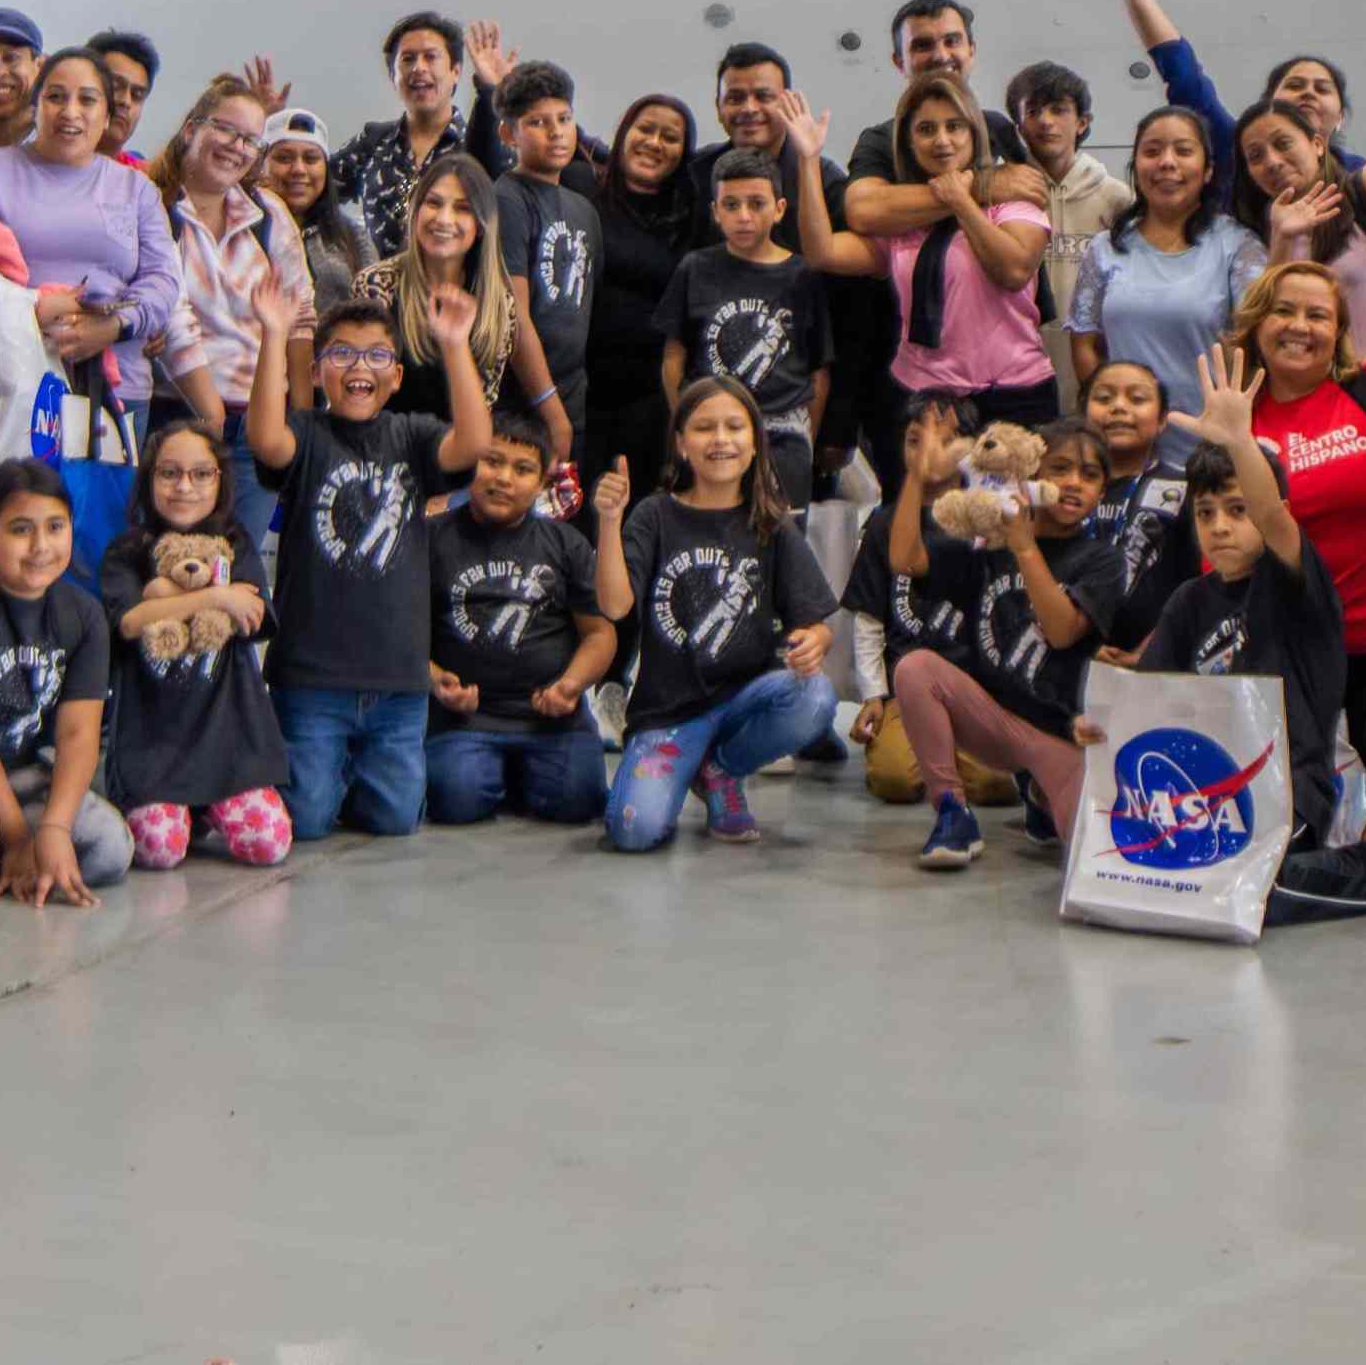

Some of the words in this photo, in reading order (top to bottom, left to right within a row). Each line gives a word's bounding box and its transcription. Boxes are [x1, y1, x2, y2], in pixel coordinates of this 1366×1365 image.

[706, 323, 722, 340] IS
[714, 301, 739, 325] FAR
[739, 298, 764, 313] OUT
[1288, 432, 1307, 448] EL
[1288, 423, 1359, 458] CENTRO
[317, 483, 337, 508] IS
[316, 508, 346, 561] SPACE
[487, 560, 516, 577] OUT
[666, 550, 693, 579] FAR
[695, 547, 724, 566] OUT
[459, 564, 487, 588] FAR
[655, 577, 674, 598] IS
[451, 584, 467, 604] IS
[452, 604, 479, 641] SPACE
[655, 600, 688, 646] SPACE
[896, 595, 924, 635] SPACE
[18, 645, 40, 667] OUT
[1122, 785, 1247, 833] NASA
[1096, 869, 1203, 893] www.nasa.gov
